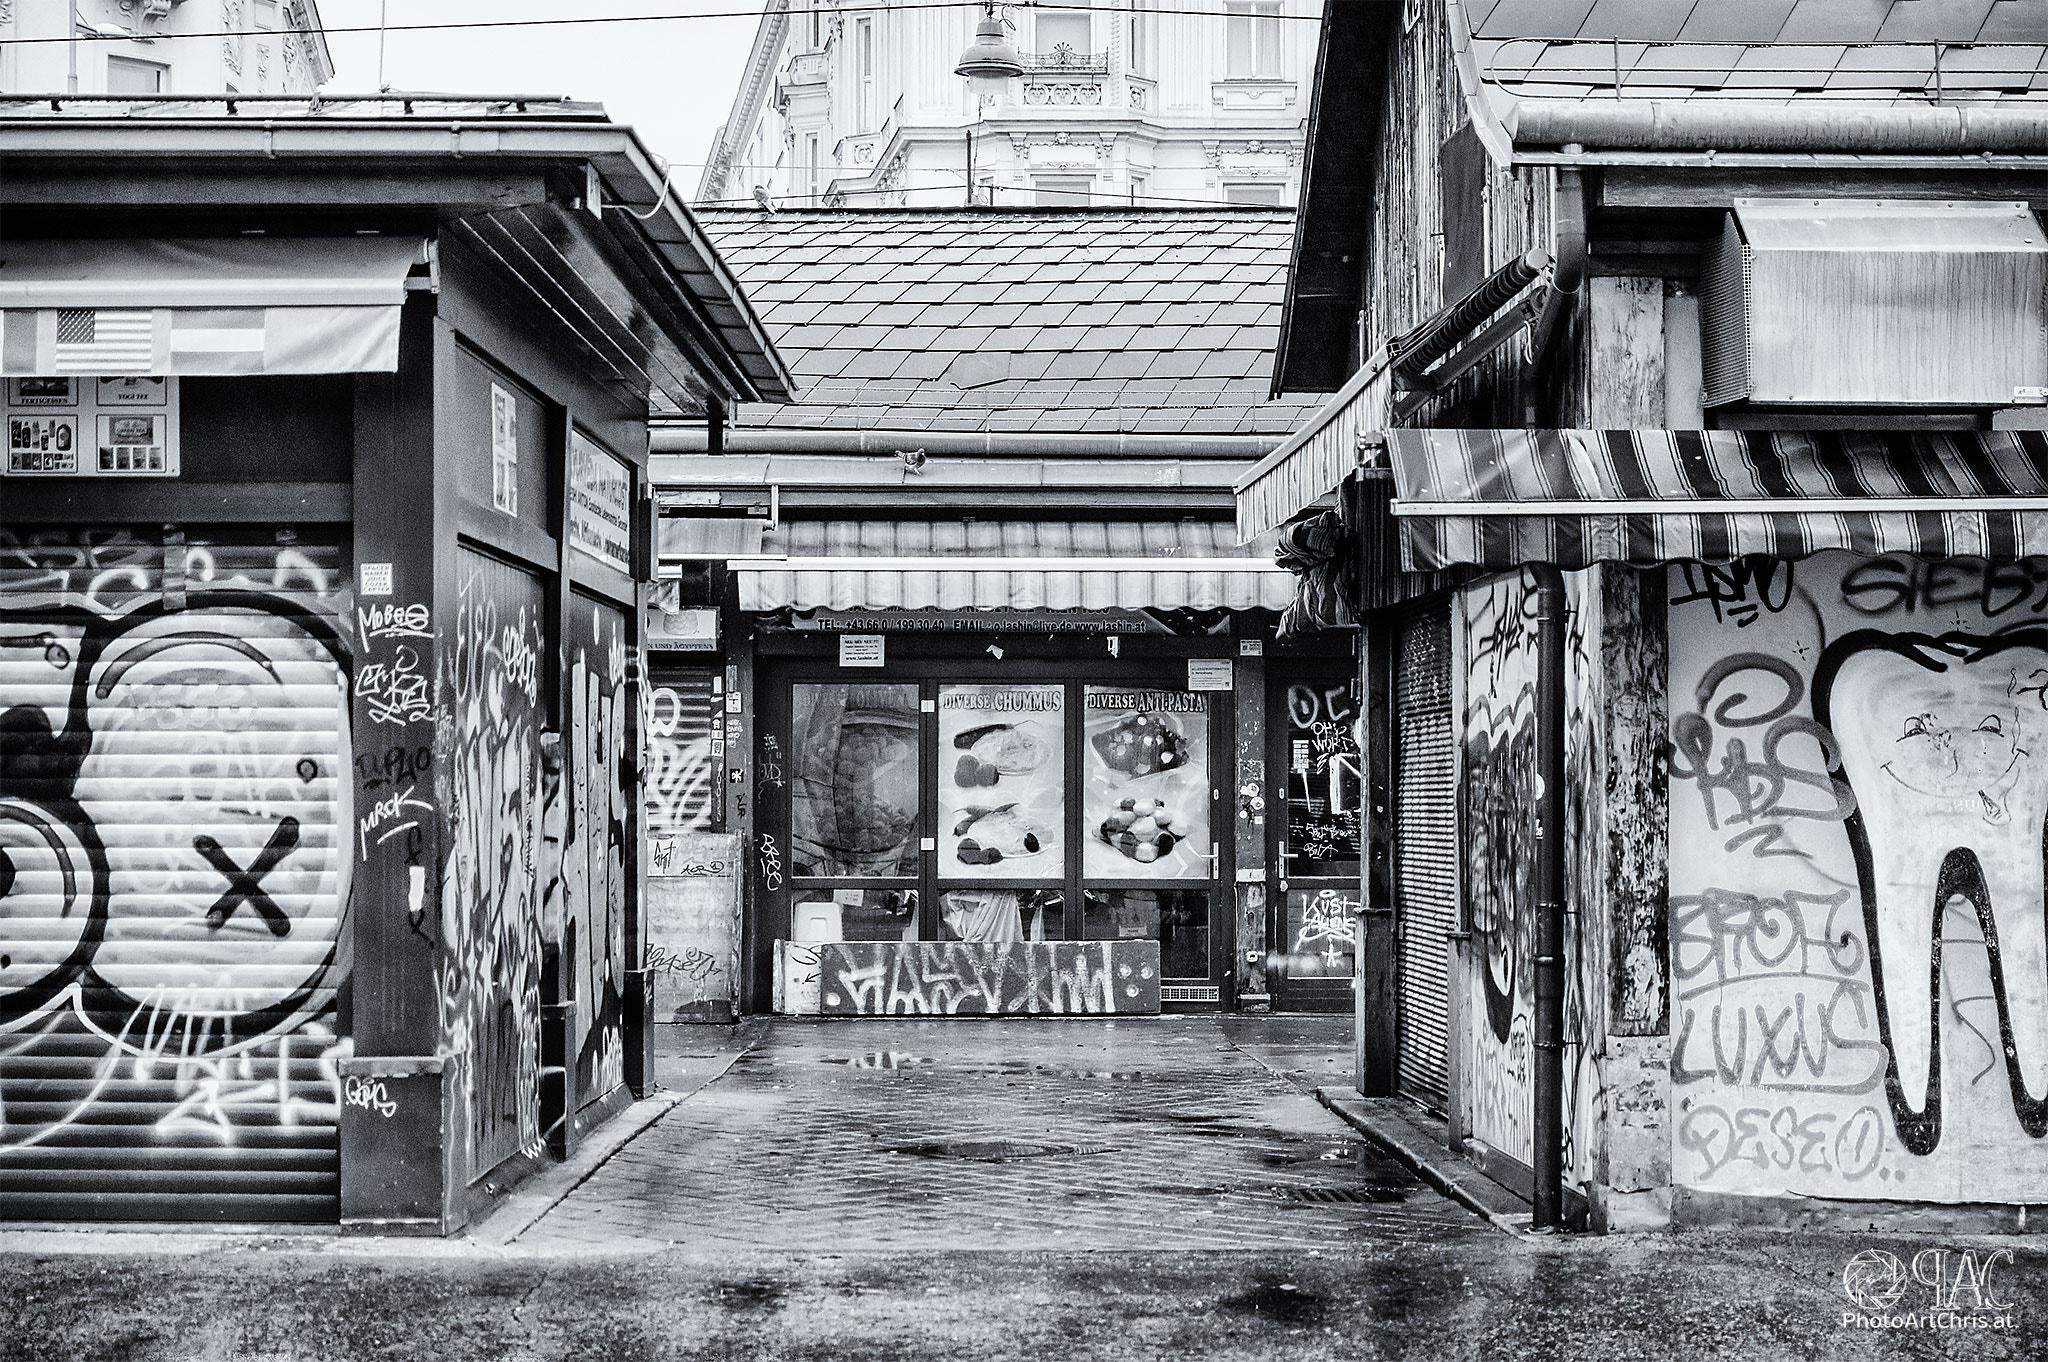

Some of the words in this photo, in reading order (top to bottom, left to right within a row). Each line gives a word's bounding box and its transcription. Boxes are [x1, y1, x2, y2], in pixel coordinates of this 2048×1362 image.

[943, 693, 991, 710] DIVERSE
[994, 690, 1062, 711] CHUMMUS
[1087, 692, 1136, 709] DIVERSE
